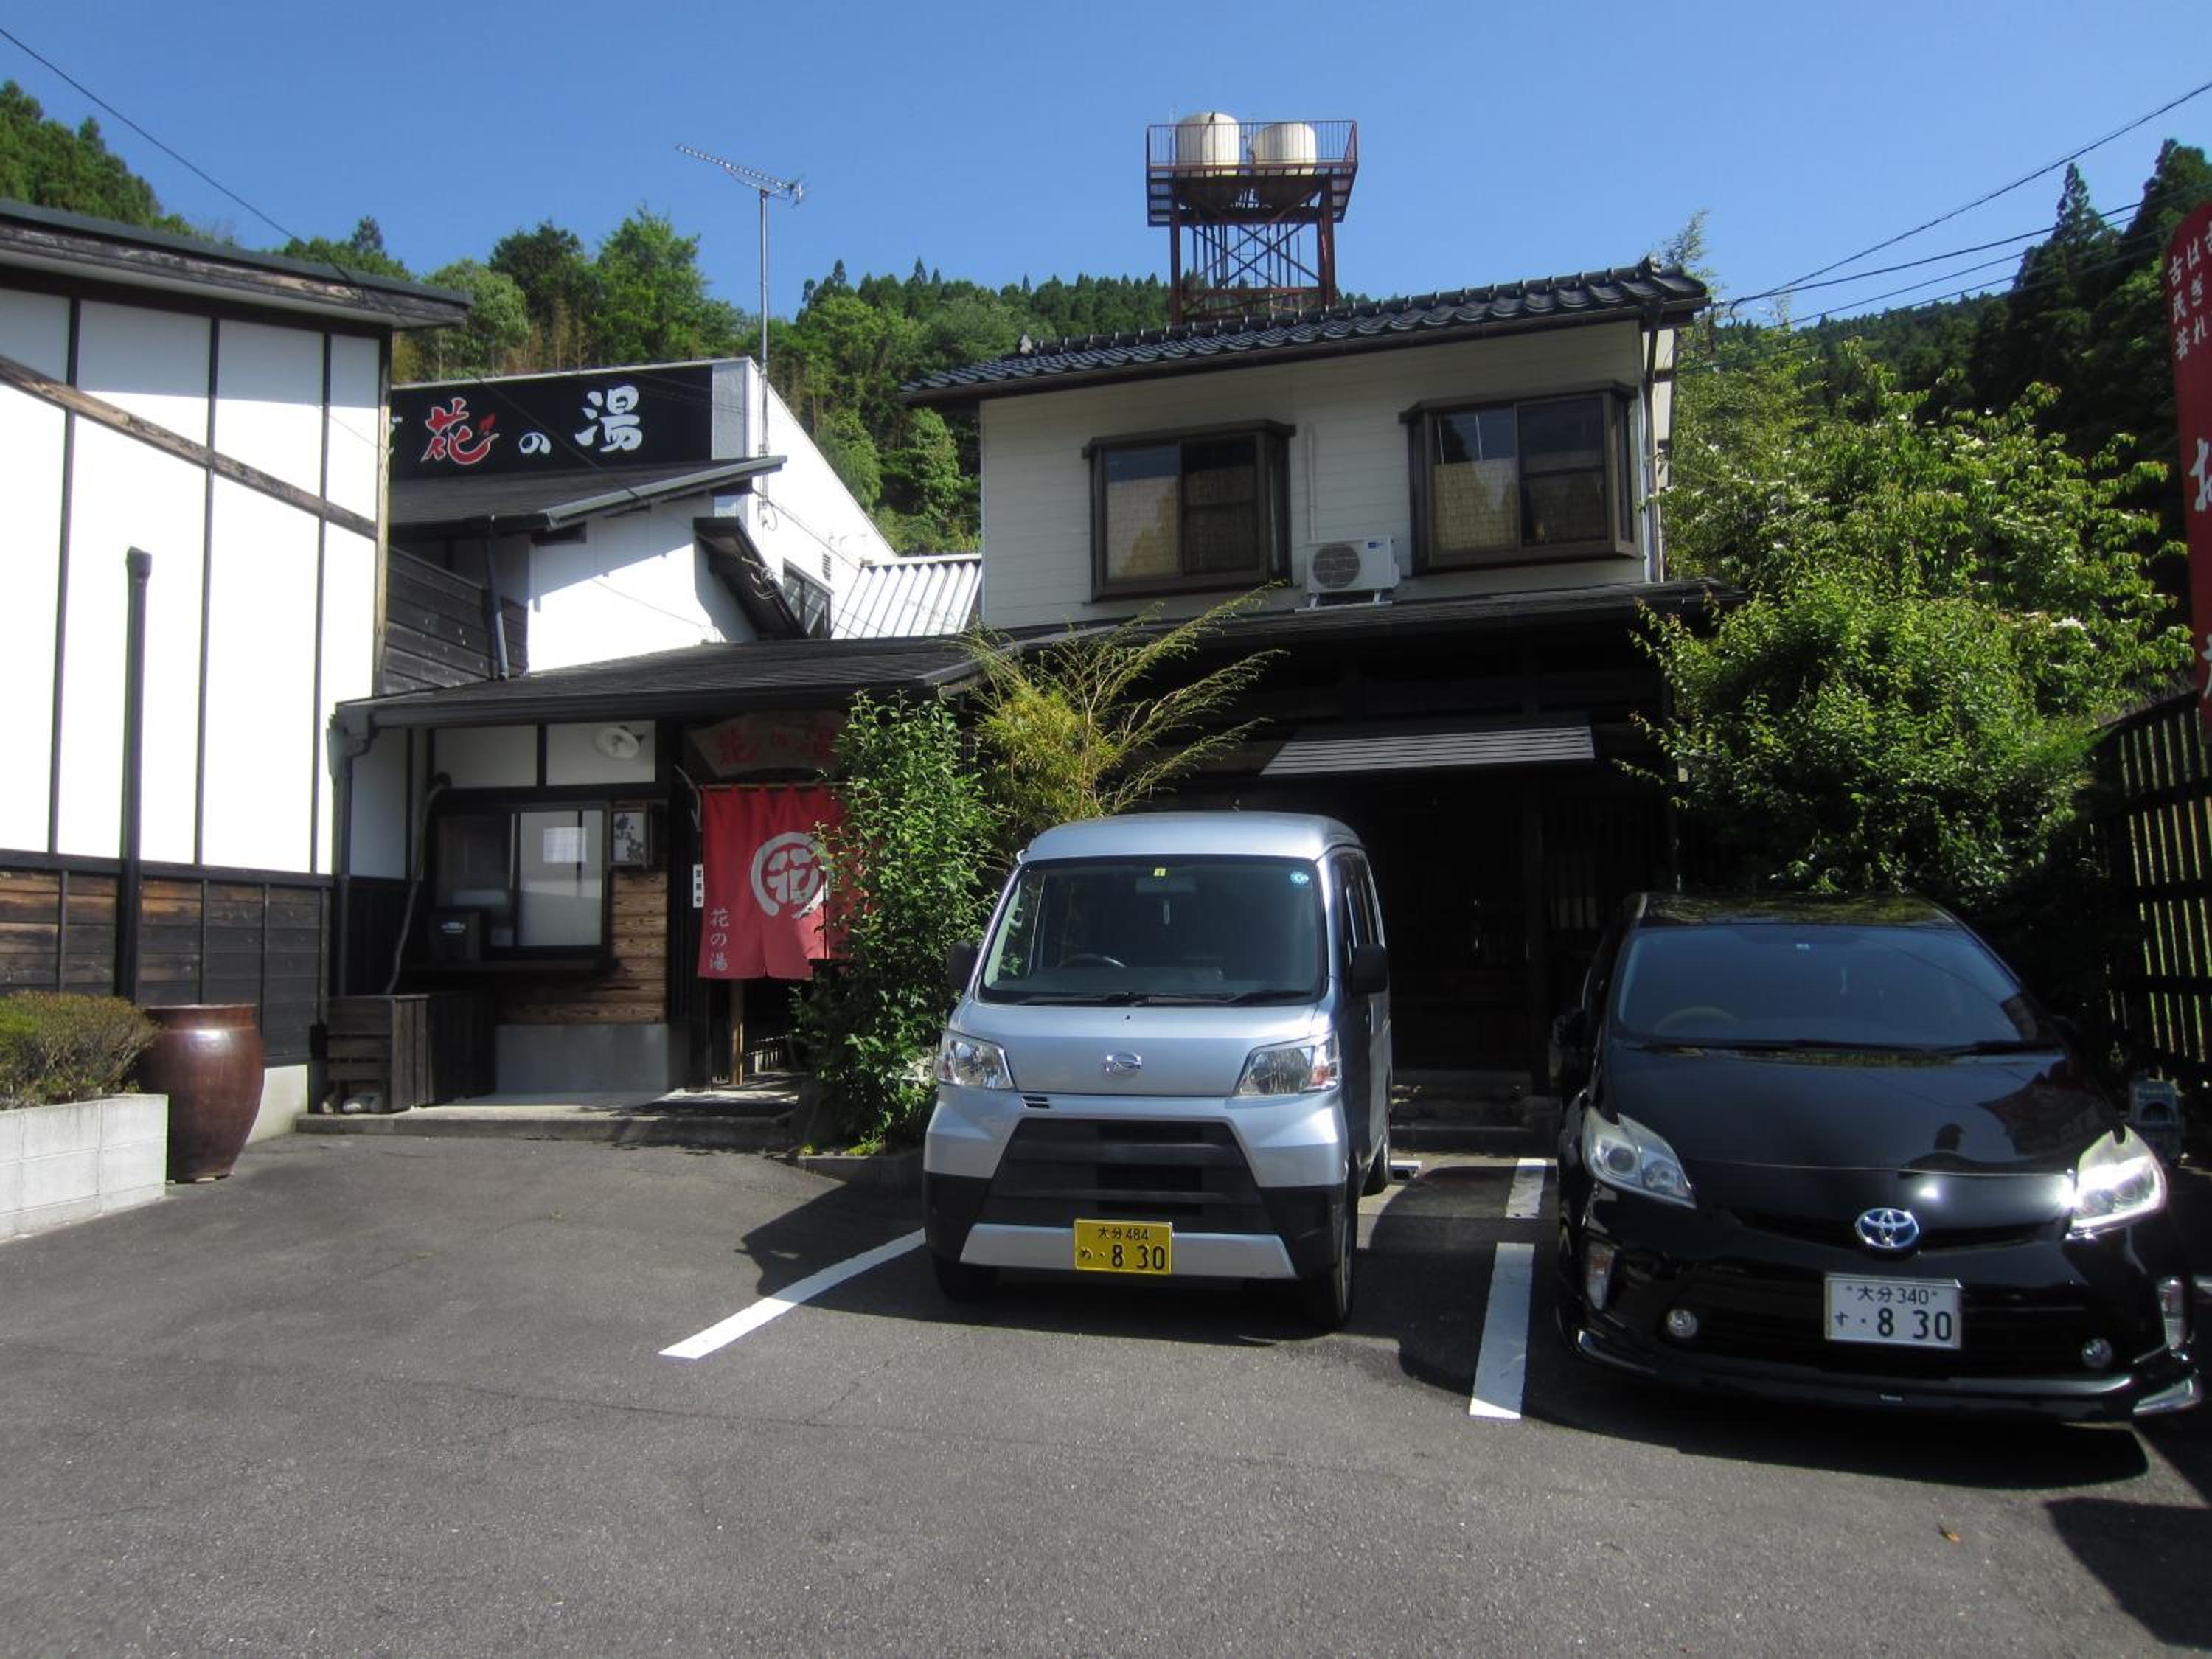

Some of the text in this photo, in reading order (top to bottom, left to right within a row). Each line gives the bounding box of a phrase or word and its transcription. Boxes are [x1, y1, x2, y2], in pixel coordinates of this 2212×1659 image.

[420, 386, 643, 465] 花の湯
[709, 907, 731, 973] 花の湯
